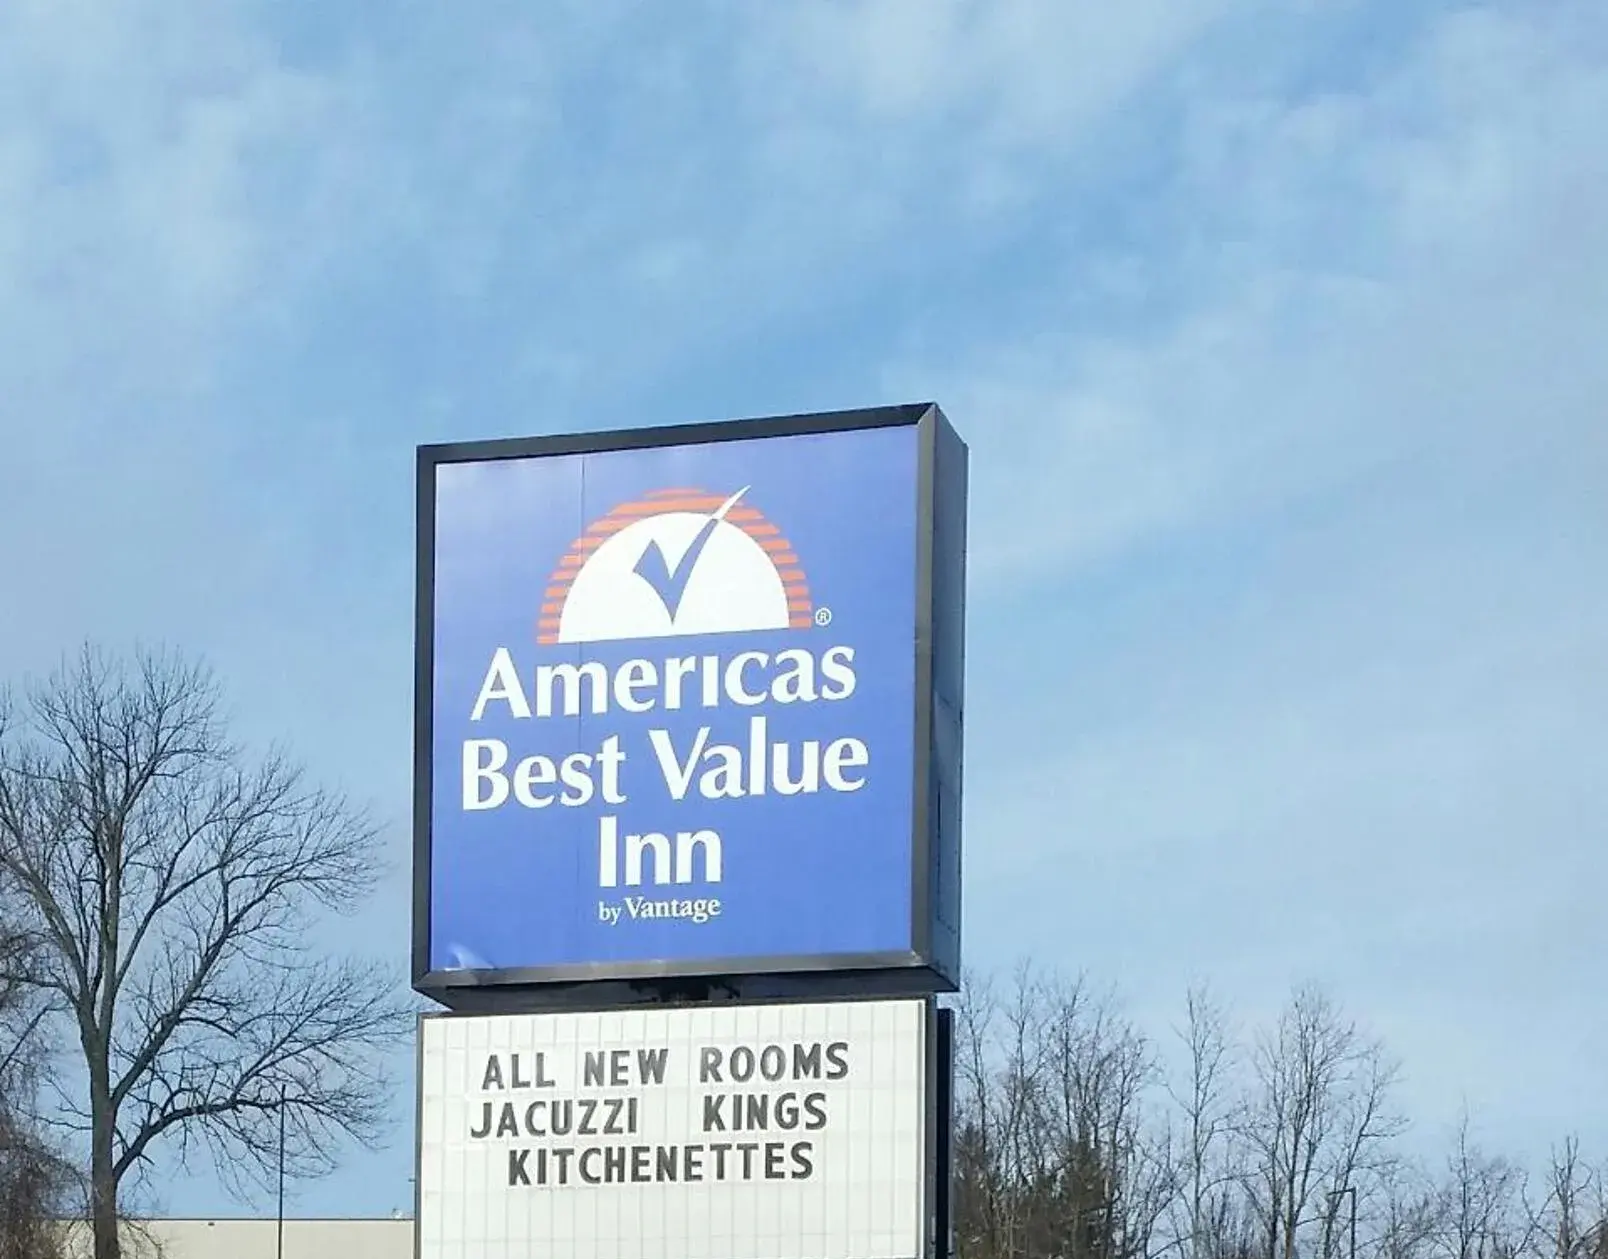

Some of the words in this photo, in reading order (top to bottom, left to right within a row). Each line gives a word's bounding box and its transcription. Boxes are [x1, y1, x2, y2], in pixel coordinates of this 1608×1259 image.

[470, 645, 857, 721] Americas
[462, 733, 627, 811] Best
[648, 716, 869, 800] Value
[599, 815, 722, 888] Inn
[598, 900, 621, 925] by
[624, 896, 721, 924] Vantage
[481, 1052, 556, 1091] ALL
[583, 1048, 669, 1087] NEW
[699, 1042, 850, 1083] ROOMS
[469, 1096, 638, 1139] JACUZZI
[702, 1092, 828, 1132] KINGS
[508, 1141, 814, 1187] KITCHENETTES
